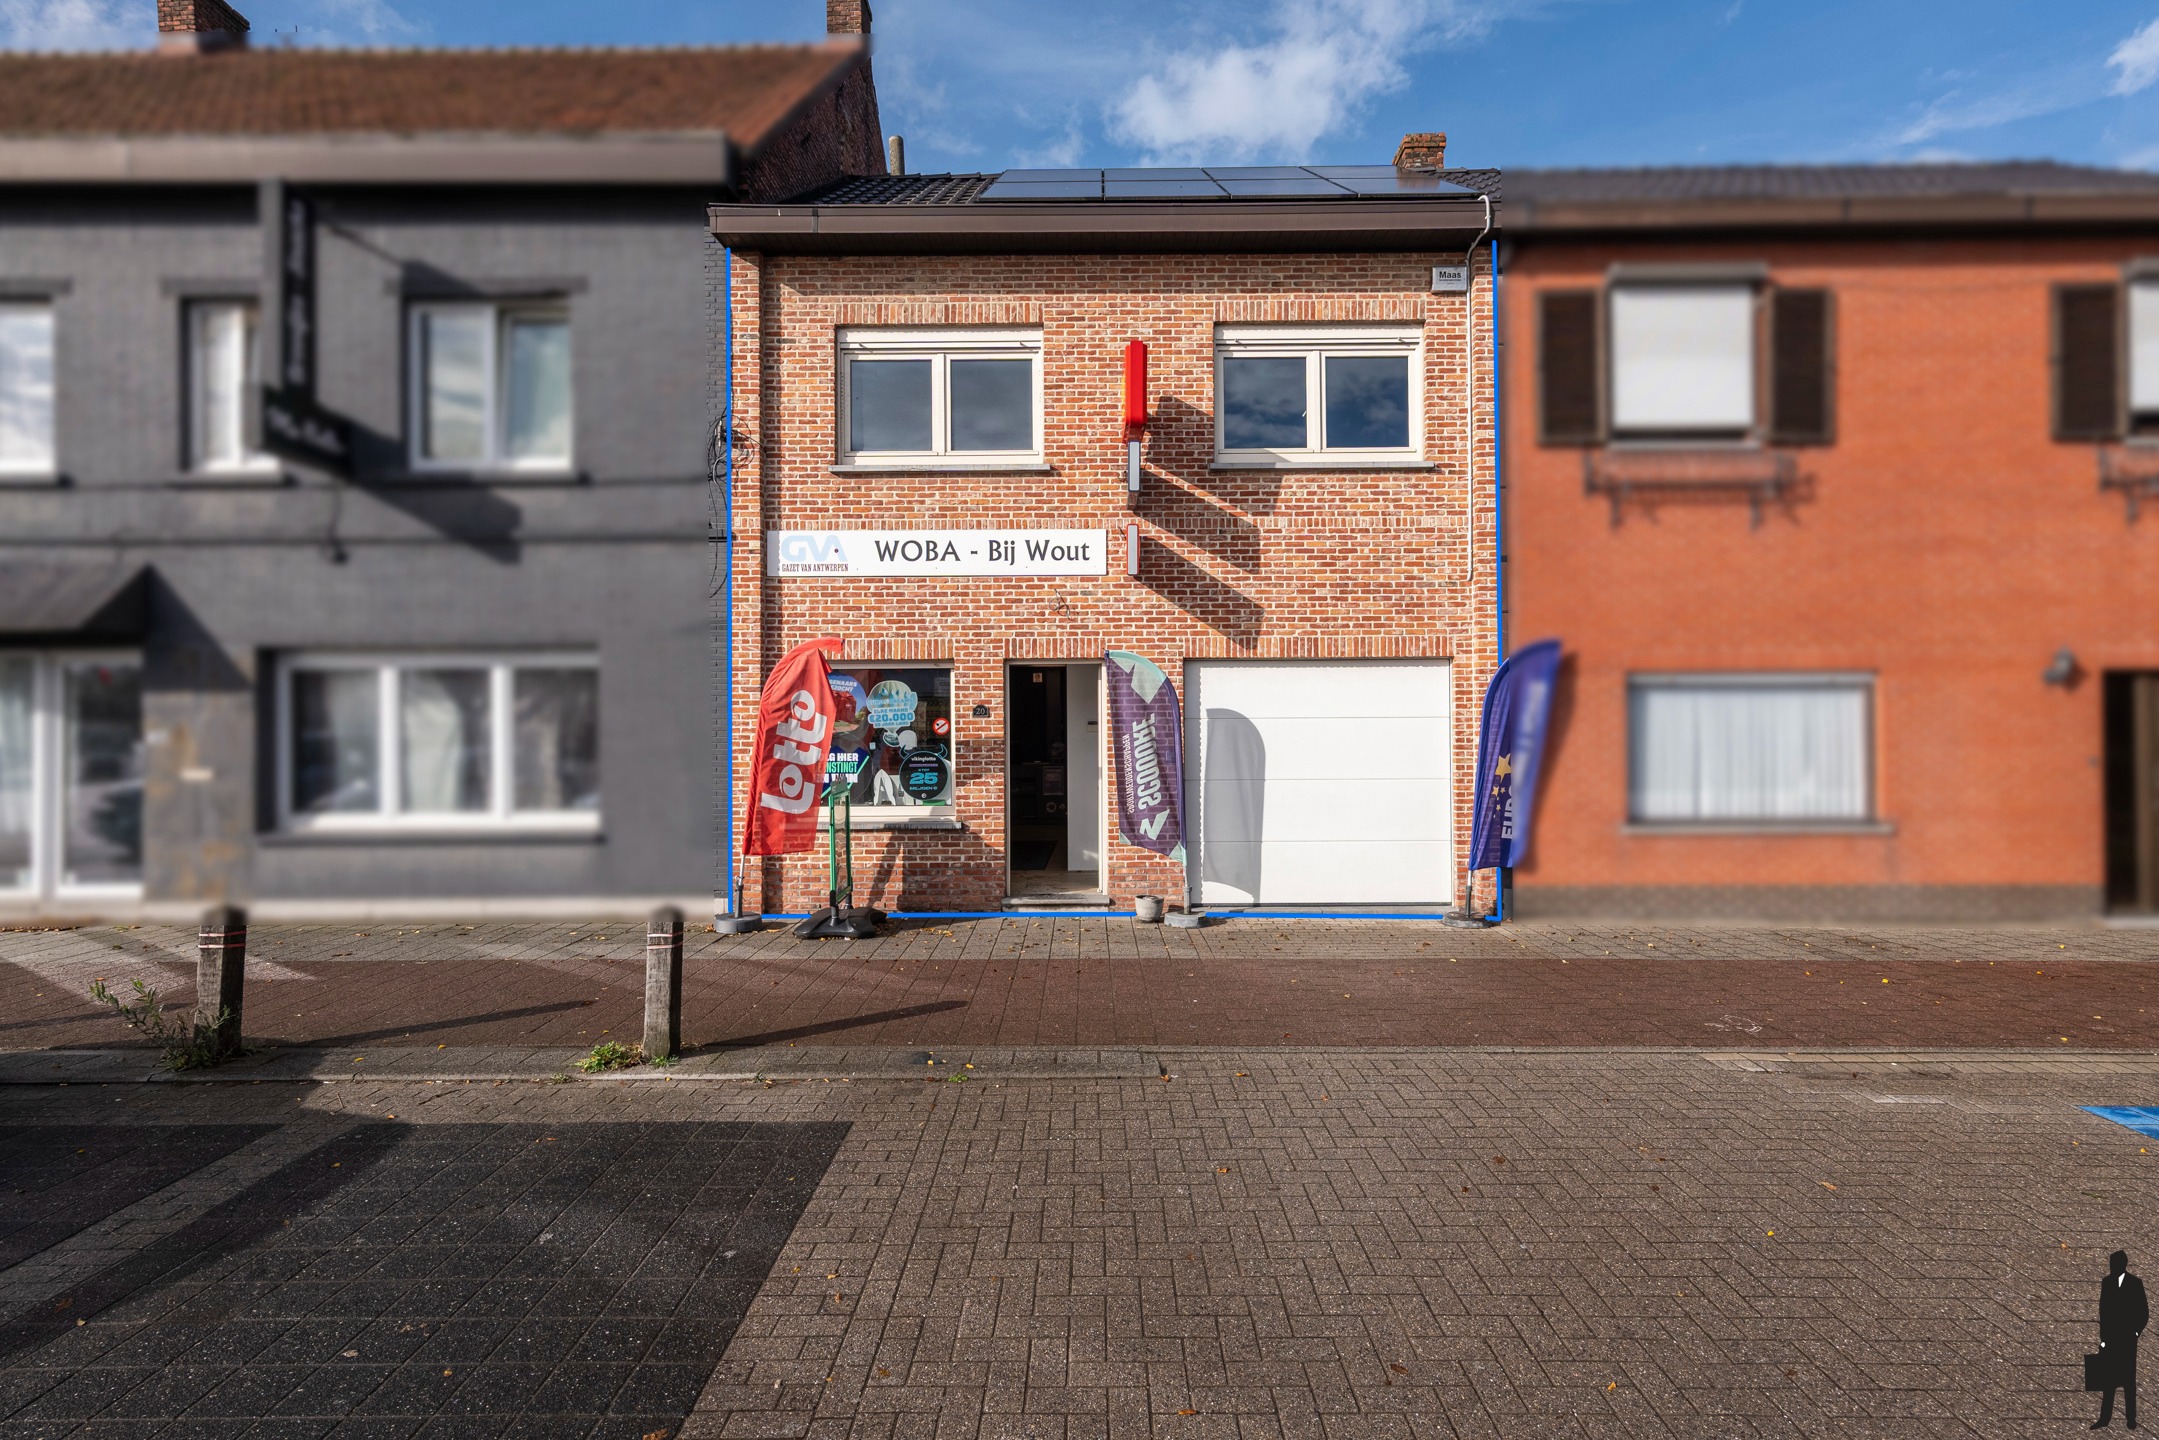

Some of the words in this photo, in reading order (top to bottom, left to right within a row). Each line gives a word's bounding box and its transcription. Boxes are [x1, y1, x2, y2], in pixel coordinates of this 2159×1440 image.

[1439, 271, 1462, 279] Maas
[781, 535, 848, 562] GVA
[874, 540, 961, 562] WOBA
[988, 540, 1016, 566] Bij
[1025, 540, 1090, 562] Wout
[782, 563, 800, 572] GAZET
[801, 563, 812, 572] VAN
[812, 563, 849, 572] ANTWERPEN
[975, 707, 986, 715] 20
[760, 689, 828, 815] Lotto
[837, 752, 859, 762] HIER
[826, 761, 859, 773] NSTINCT
[909, 772, 939, 785] 25
